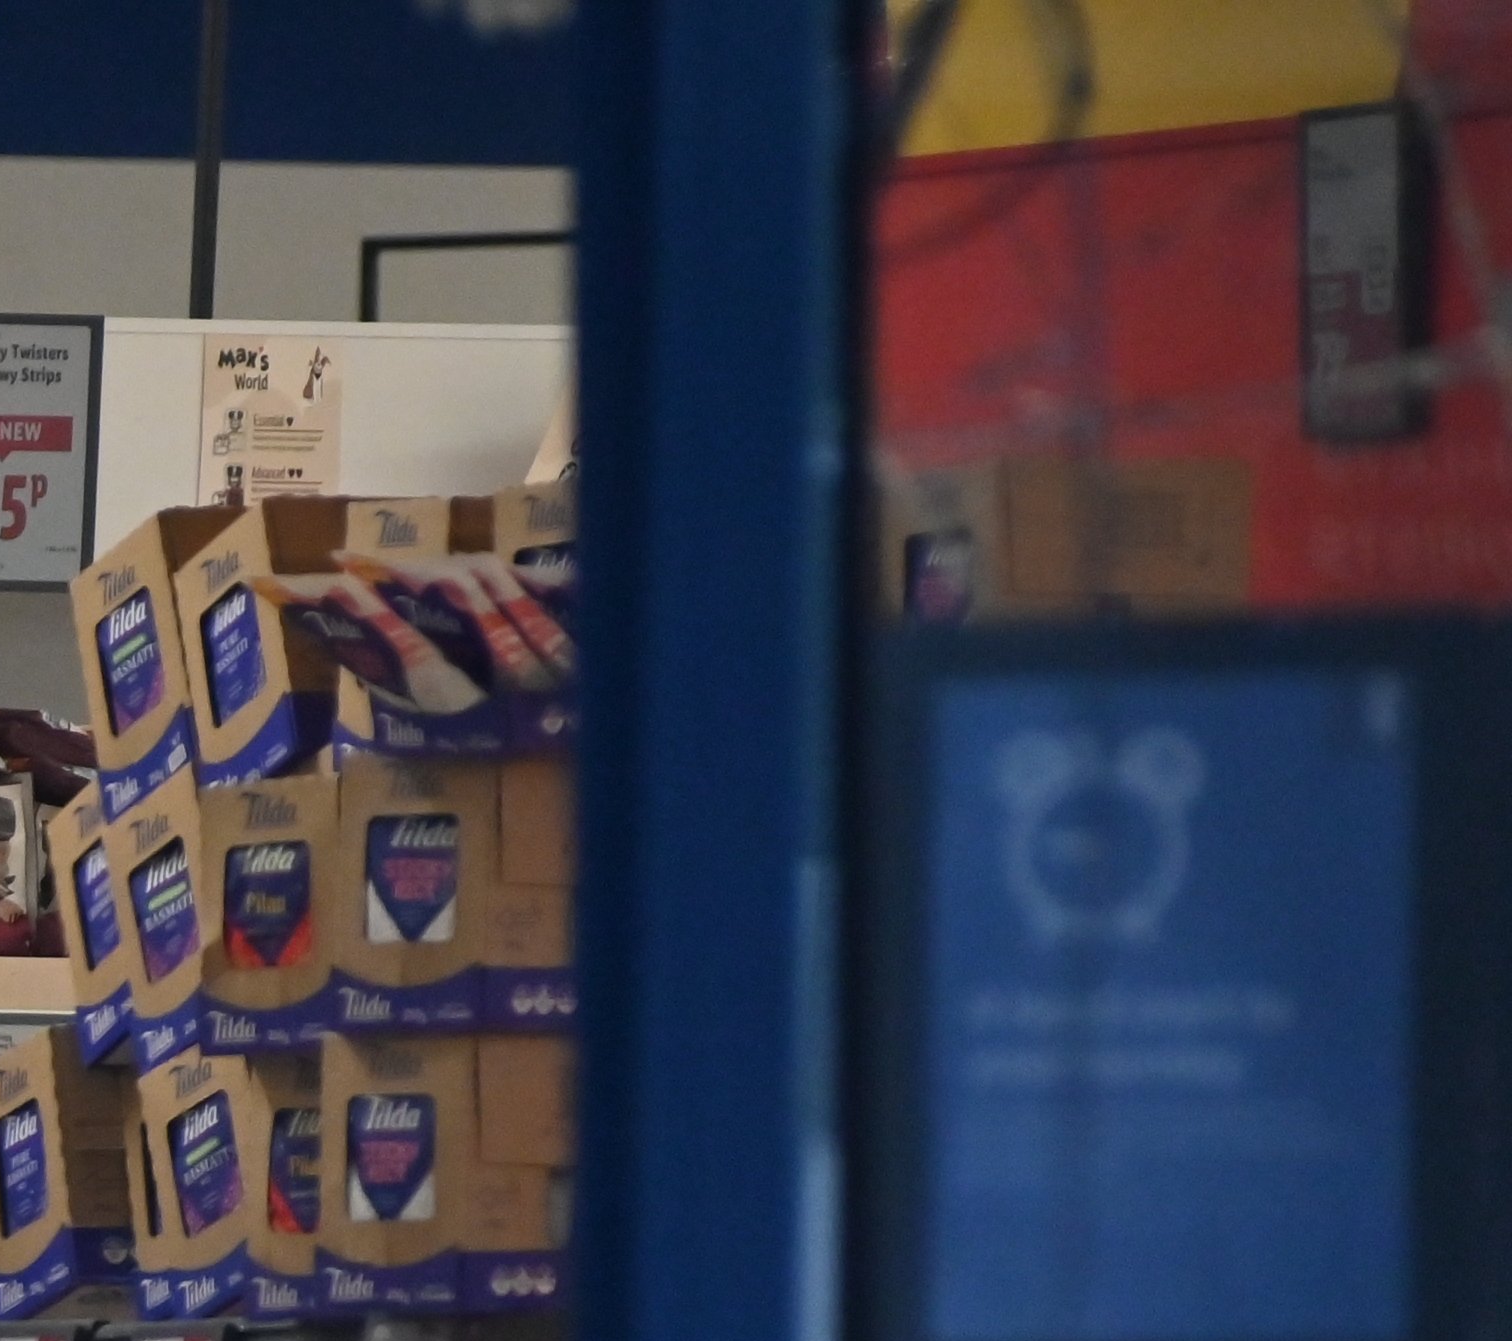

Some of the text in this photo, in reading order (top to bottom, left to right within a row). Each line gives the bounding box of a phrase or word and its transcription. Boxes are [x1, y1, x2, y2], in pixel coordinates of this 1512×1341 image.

[13, 343, 69, 361] Twisters
[217, 345, 270, 372] Max's
[21, 366, 62, 386] Strips
[234, 373, 269, 391] World
[0, 421, 42, 442] NEW
[375, 509, 419, 547] Tilda
[97, 564, 137, 606] Tilda
[201, 551, 241, 593] Tilda
[339, 985, 393, 1022] Tilda
[141, 1025, 176, 1062] Tilda
[208, 1009, 258, 1045] Tilda
[169, 1060, 212, 1099] Tilda
[183, 1103, 219, 1146] Tilda
[365, 1095, 422, 1131] Tilda
[178, 1276, 218, 1310] Tilda
[253, 1276, 299, 1309] Tilda
[326, 1266, 376, 1301] Tilda
